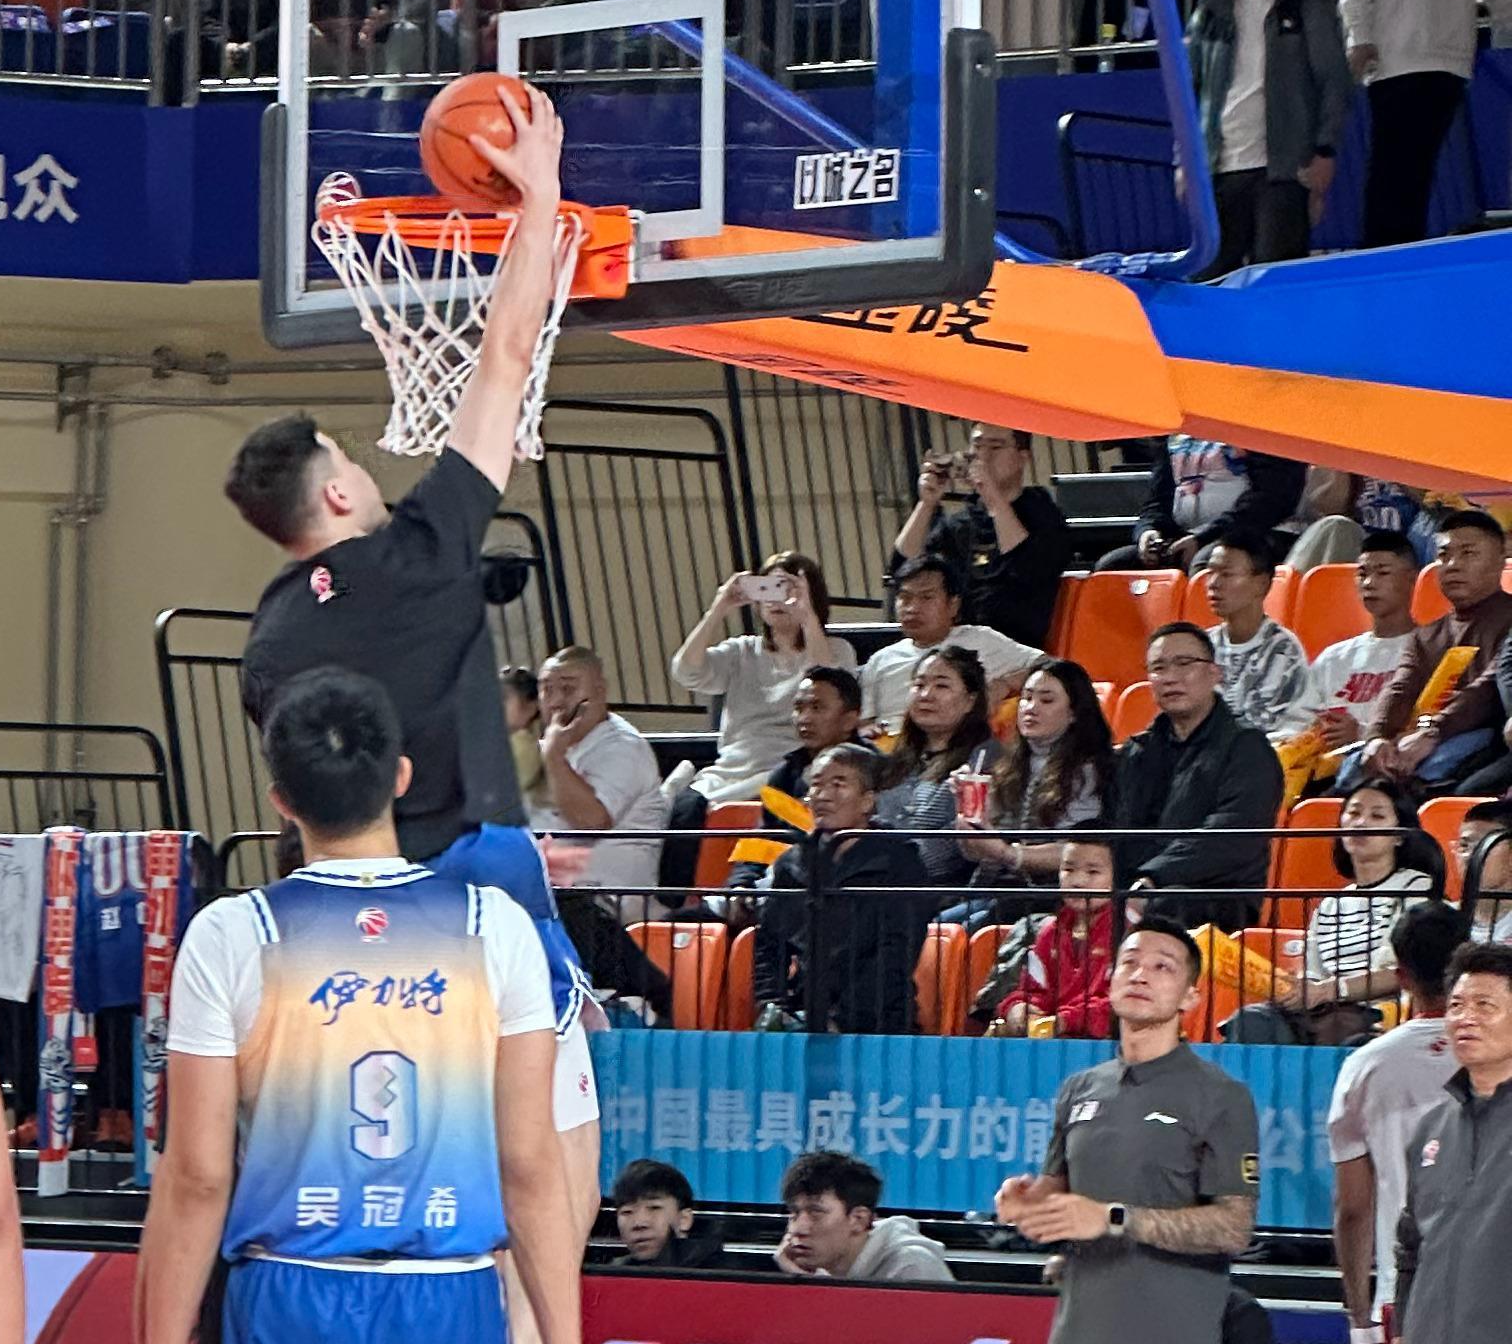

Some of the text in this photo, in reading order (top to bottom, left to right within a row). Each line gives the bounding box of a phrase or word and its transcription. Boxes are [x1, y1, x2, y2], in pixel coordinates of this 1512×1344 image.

[308, 969, 448, 1026] 伊力特
[350, 1051, 417, 1160] 9
[296, 1184, 458, 1229] 吴冠希
